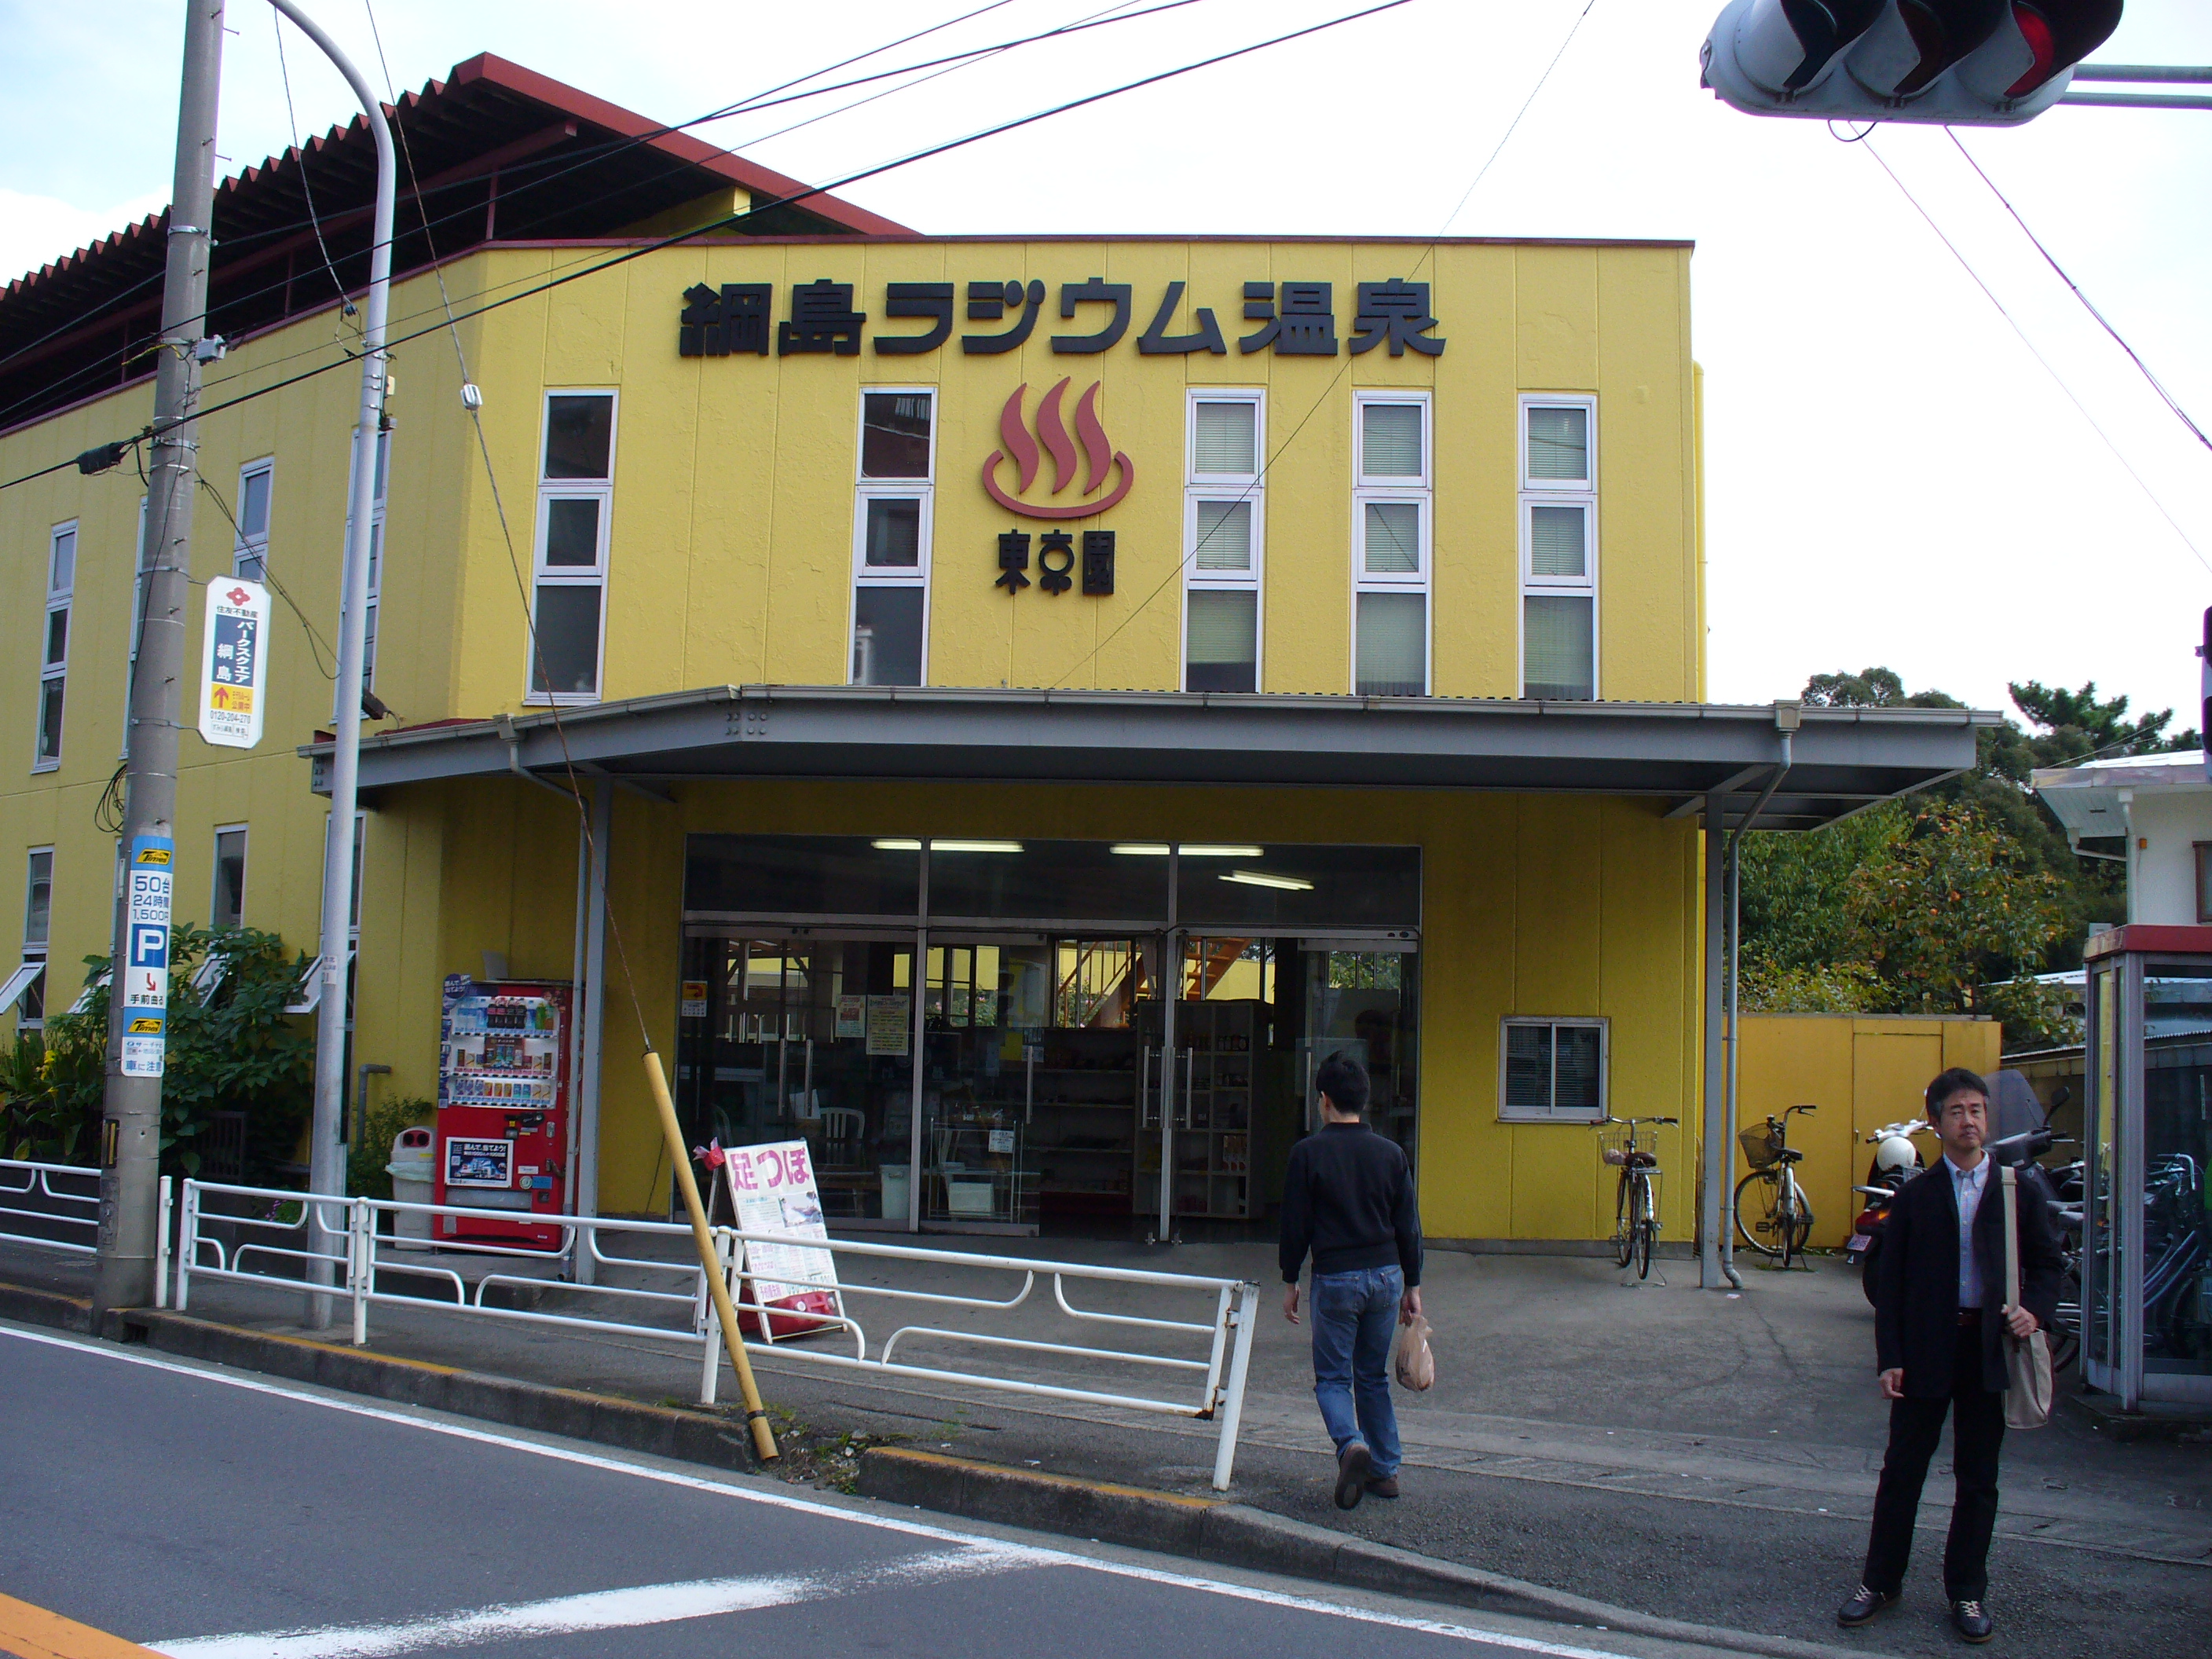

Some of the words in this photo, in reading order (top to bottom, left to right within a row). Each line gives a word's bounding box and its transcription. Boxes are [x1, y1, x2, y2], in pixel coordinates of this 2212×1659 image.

[680, 278, 1446, 357] 綱島ラジウム温泉
[995, 529, 1115, 595] 東京園
[216, 643, 234, 682] 綱島
[235, 621, 255, 683] パークスクエア
[142, 851, 169, 863] Times
[134, 875, 170, 894] 50台
[137, 929, 164, 961] P
[130, 994, 163, 1005] 手前曲る
[134, 1020, 162, 1032] Times
[730, 1147, 810, 1192] 足つぼ
